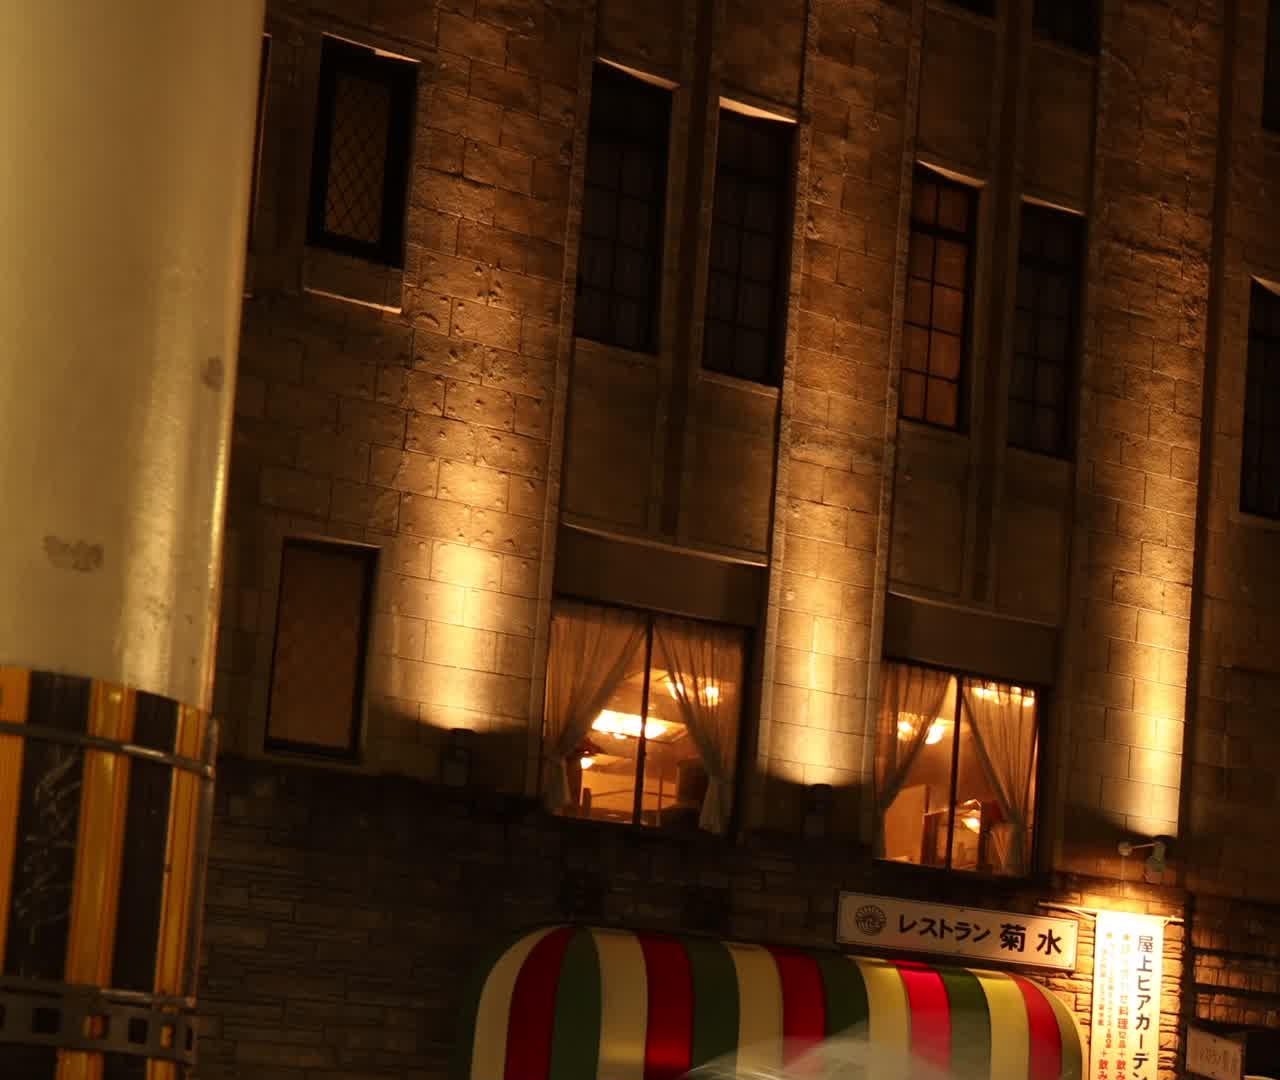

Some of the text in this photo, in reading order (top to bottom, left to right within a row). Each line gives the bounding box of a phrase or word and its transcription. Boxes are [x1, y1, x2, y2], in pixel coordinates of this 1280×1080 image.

[899, 915, 1062, 955] レストラン 菊水
